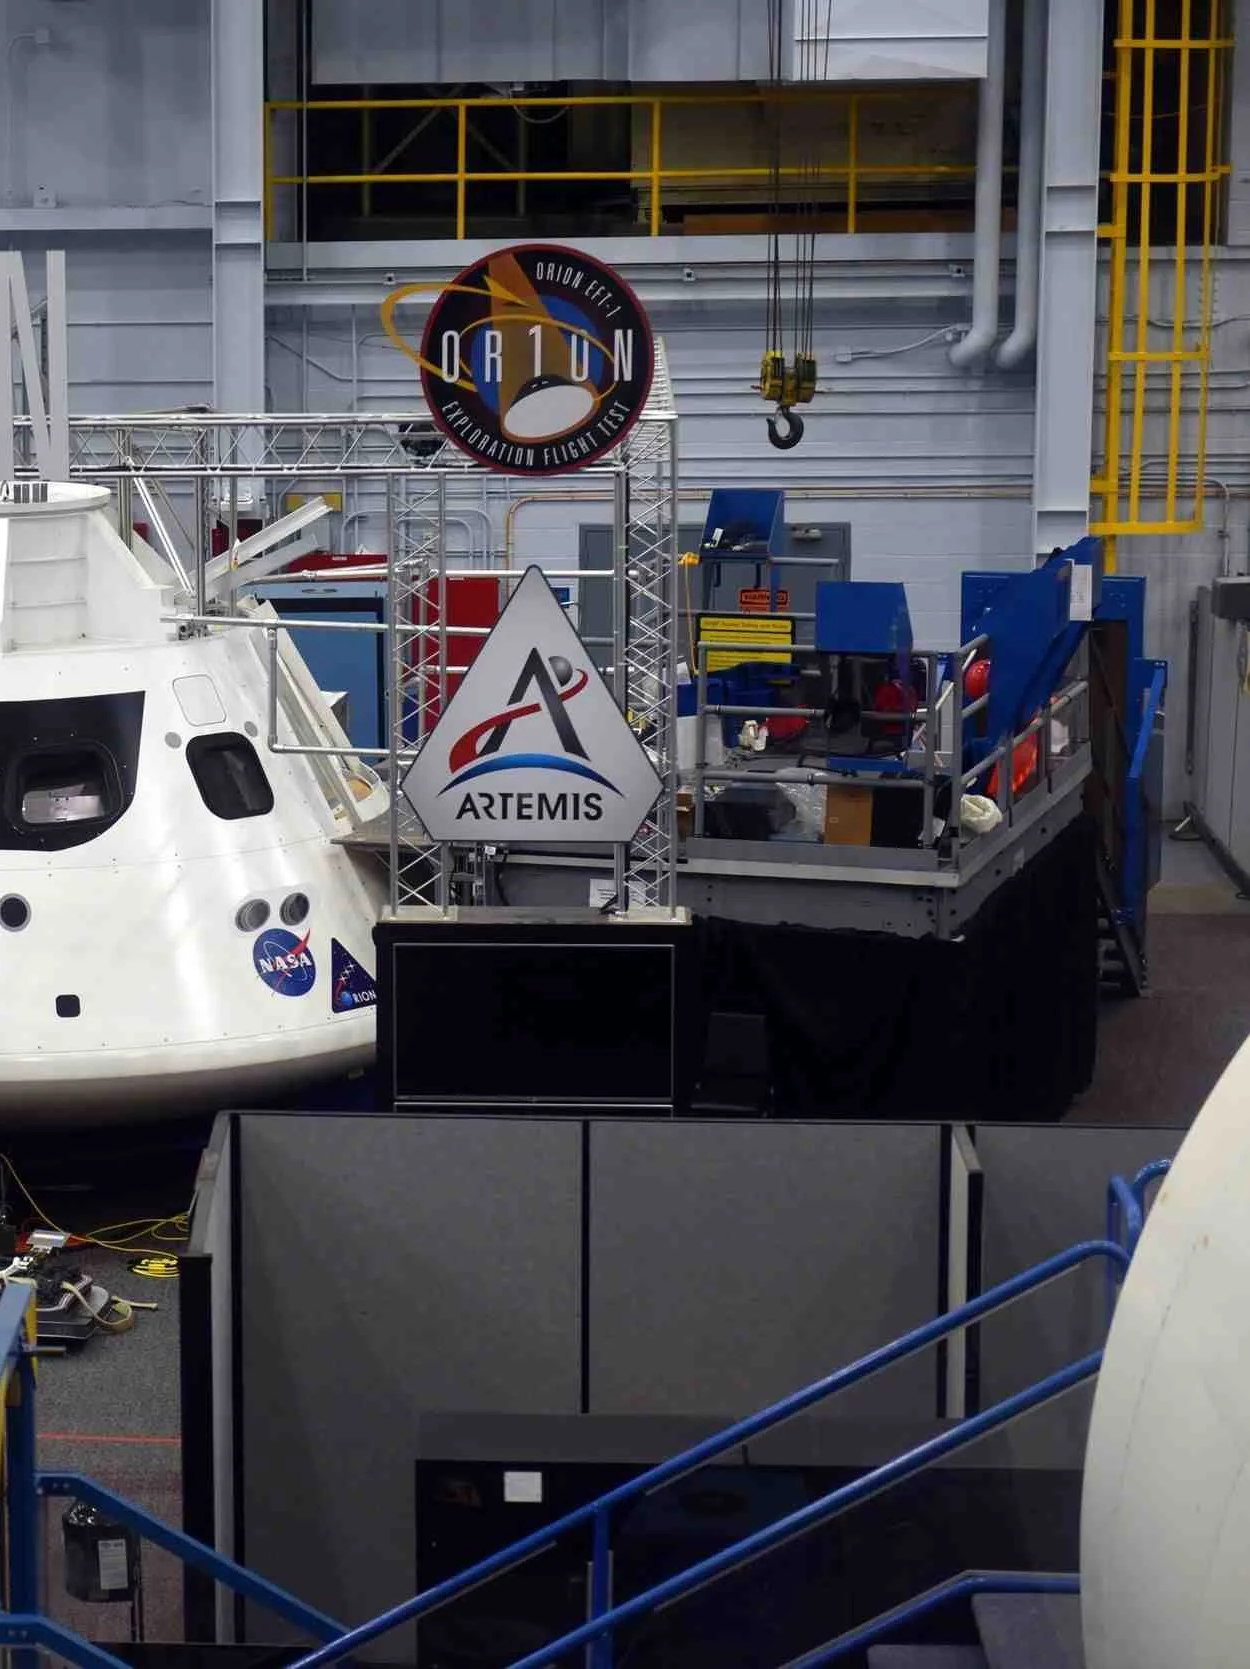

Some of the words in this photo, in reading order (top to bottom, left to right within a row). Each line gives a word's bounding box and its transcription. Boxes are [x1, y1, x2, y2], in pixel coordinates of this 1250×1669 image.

[536, 262, 586, 289] ORION
[585, 280, 621, 318] EFT-1
[442, 400, 534, 466] EXPLORATION
[544, 432, 598, 466] FLIGHT
[597, 400, 630, 437] TEST
[455, 792, 603, 821] ARTEMIS
[258, 952, 312, 973] NASA
